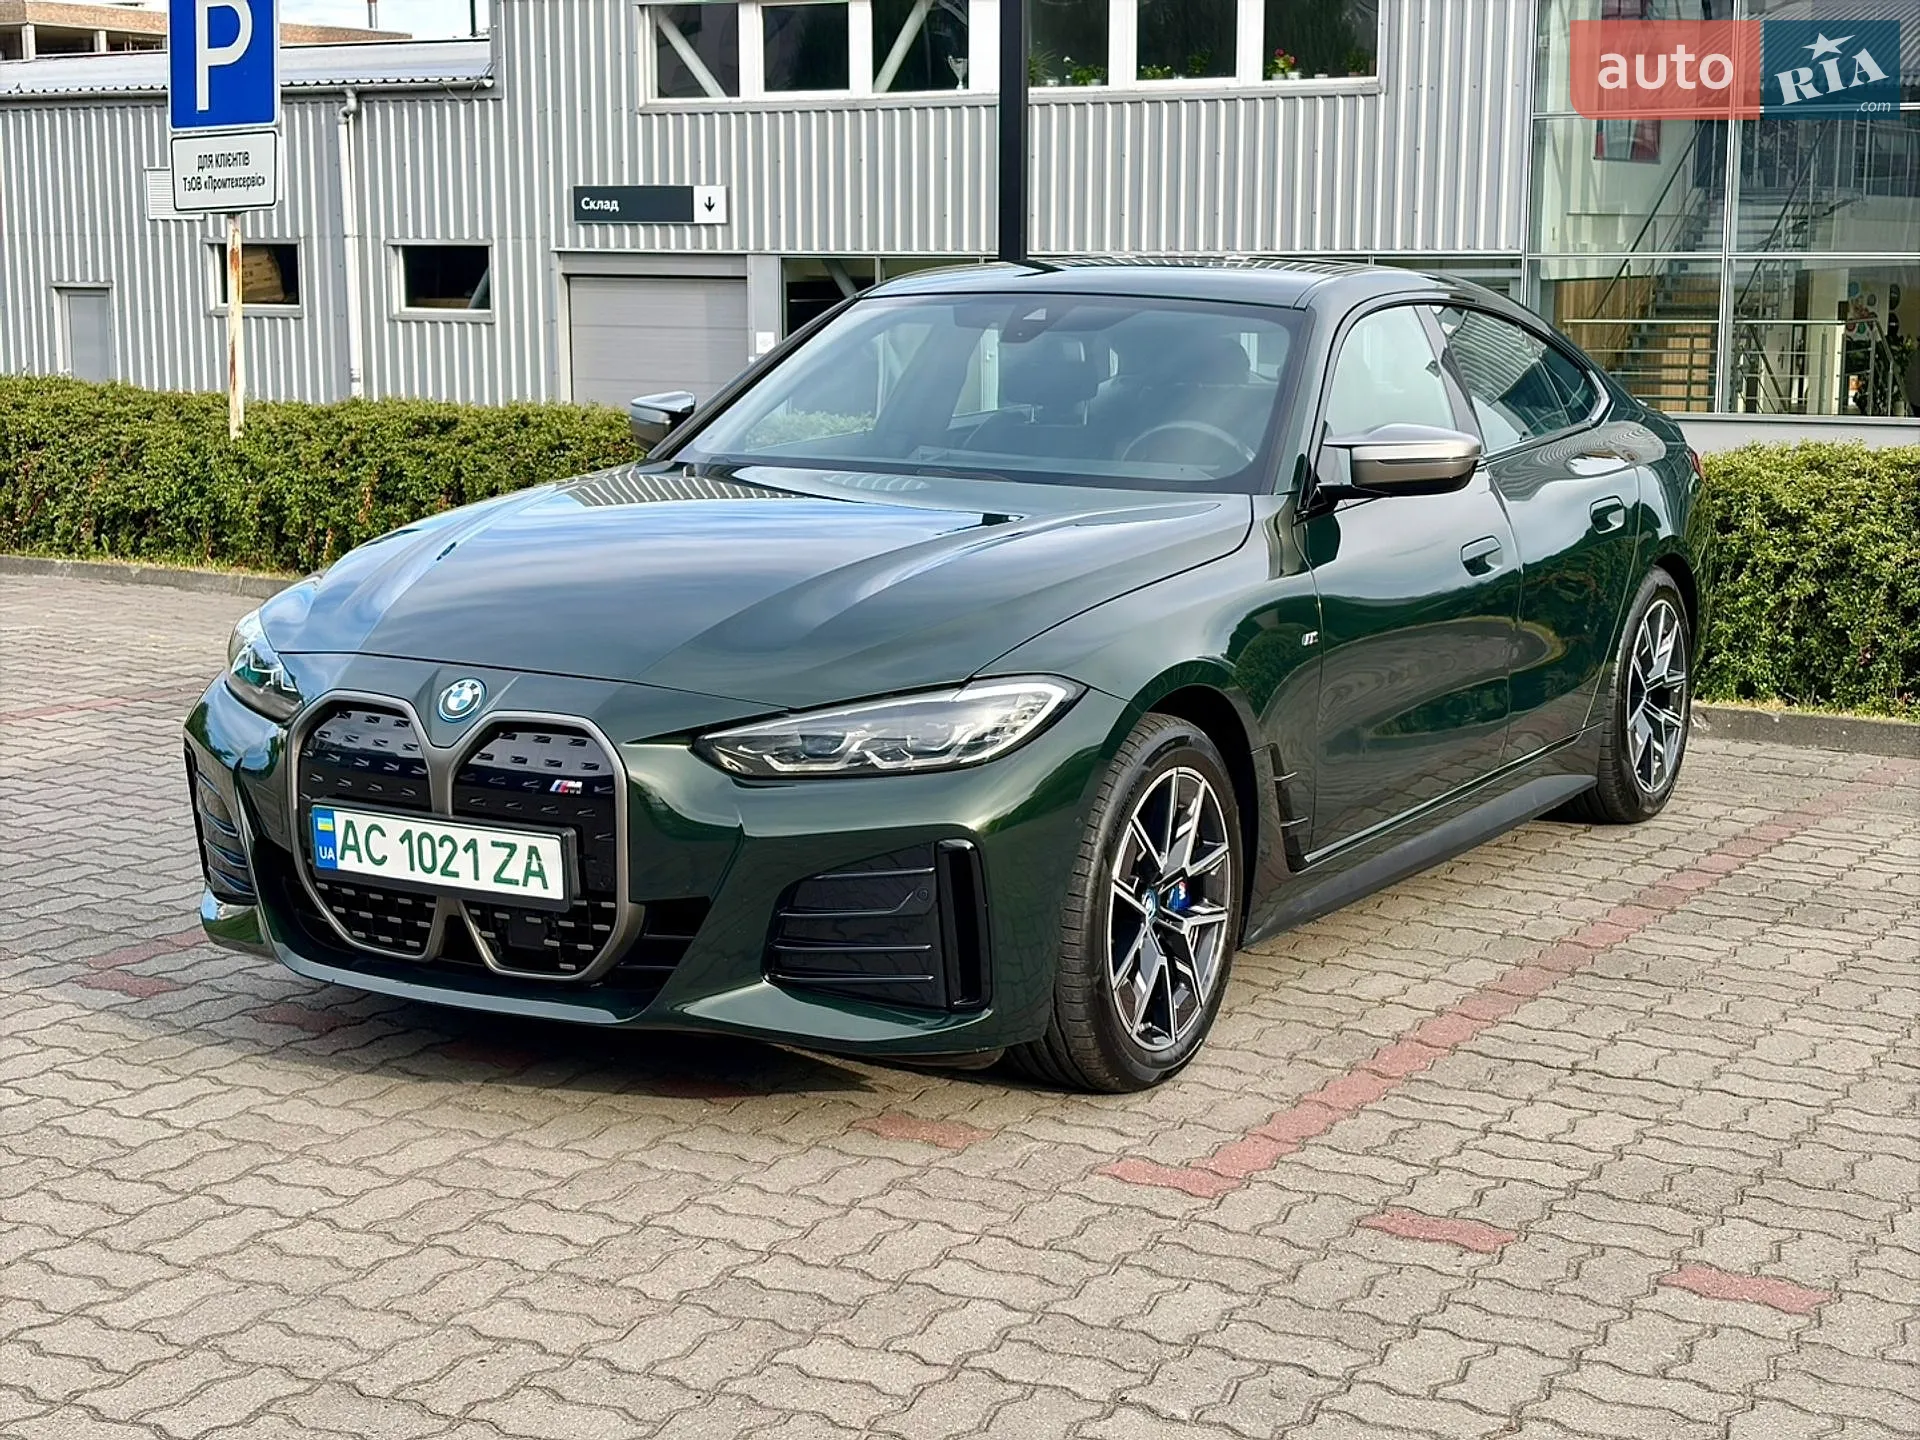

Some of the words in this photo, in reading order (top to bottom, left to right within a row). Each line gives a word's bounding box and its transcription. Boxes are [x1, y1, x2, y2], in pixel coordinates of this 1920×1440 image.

[195, 0, 253, 111] P
[197, 154, 213, 172] ДЛЯ
[214, 151, 250, 168] КЛІЄНТІВ
[580, 196, 620, 213] Склад
[319, 848, 336, 861] UA
[339, 819, 389, 867] AC
[398, 828, 481, 881] 1021
[490, 840, 549, 890] ZA
